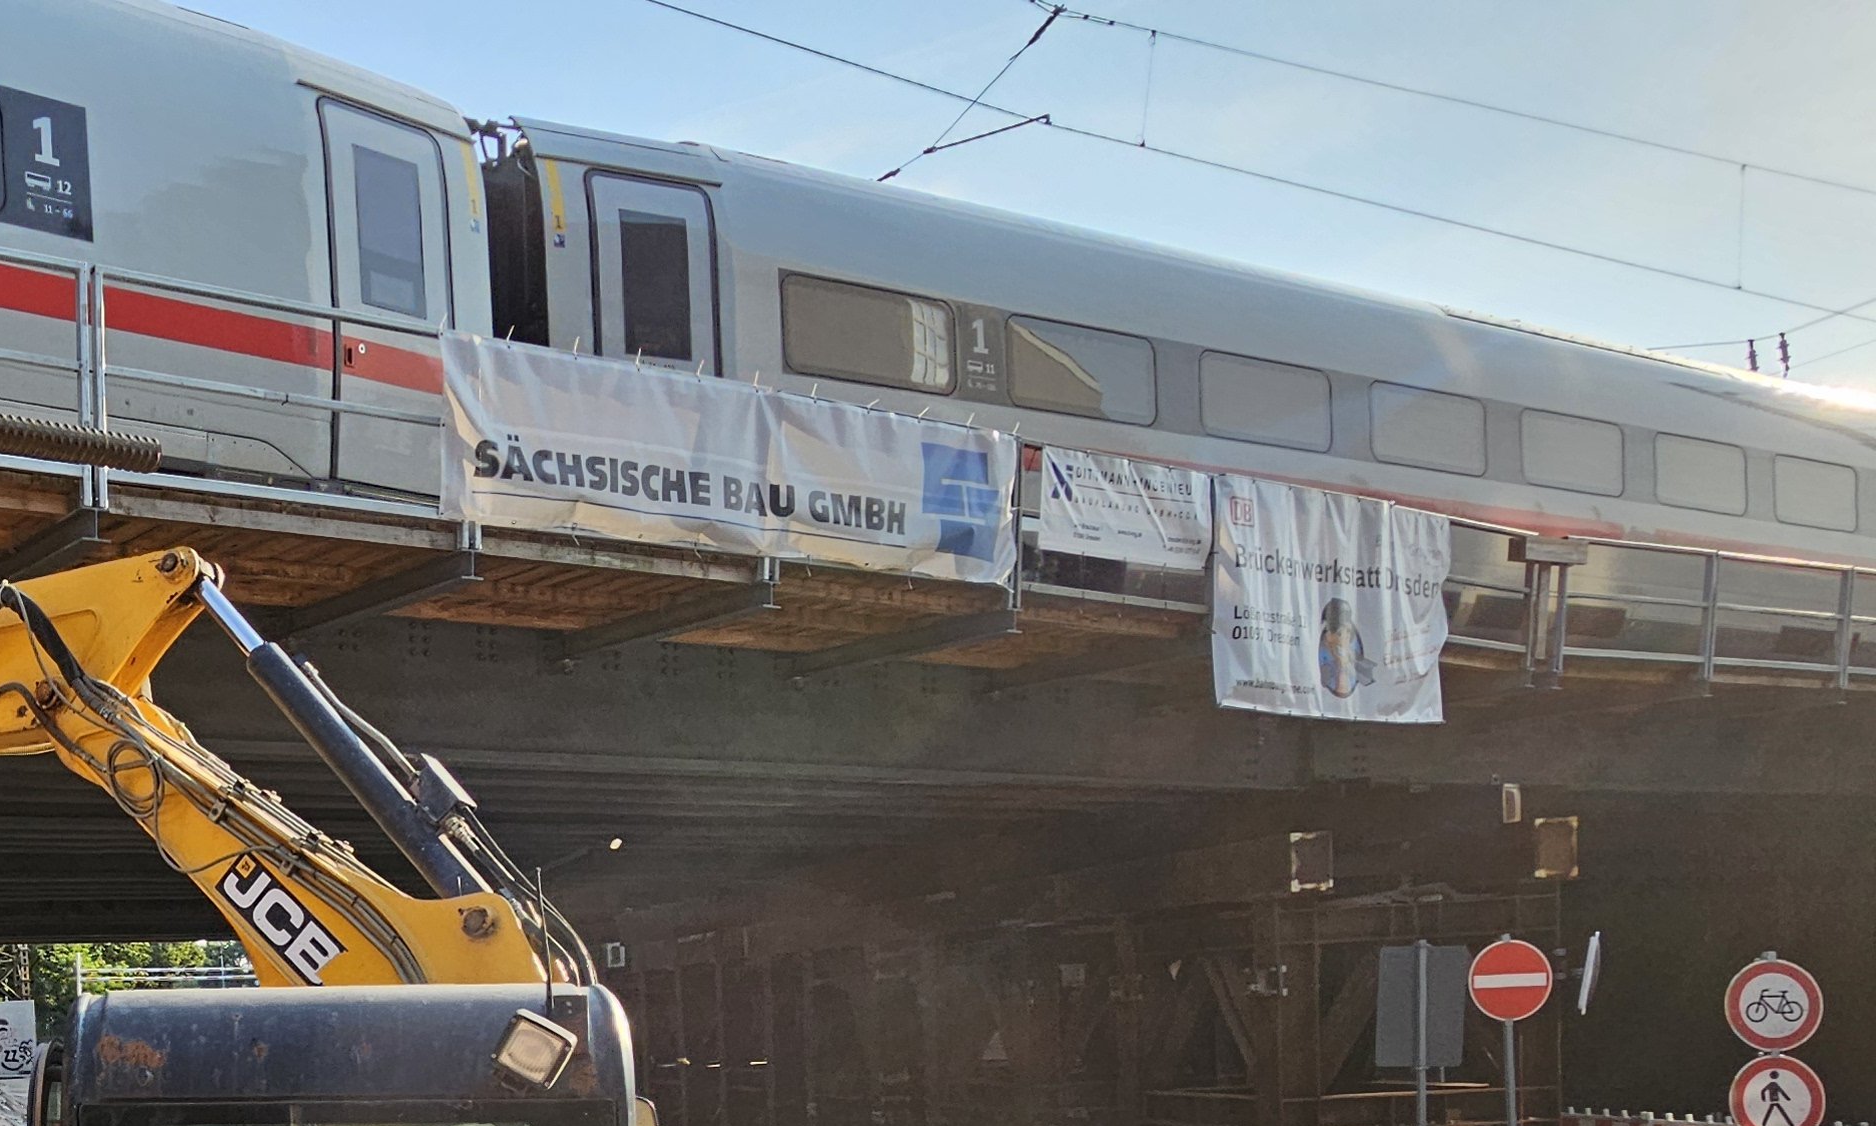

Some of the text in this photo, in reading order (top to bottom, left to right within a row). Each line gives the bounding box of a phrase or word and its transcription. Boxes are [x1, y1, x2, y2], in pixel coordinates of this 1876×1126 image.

[32, 116, 60, 167] 1
[56, 180, 72, 195] 12
[972, 319, 989, 354] 1
[986, 364, 995, 374] 11
[474, 434, 906, 535] SÄCHSISCHE BAU GMBH
[1233, 499, 1253, 523] DB
[1385, 567, 1440, 600] Drsden
[224, 871, 341, 985] JCB
